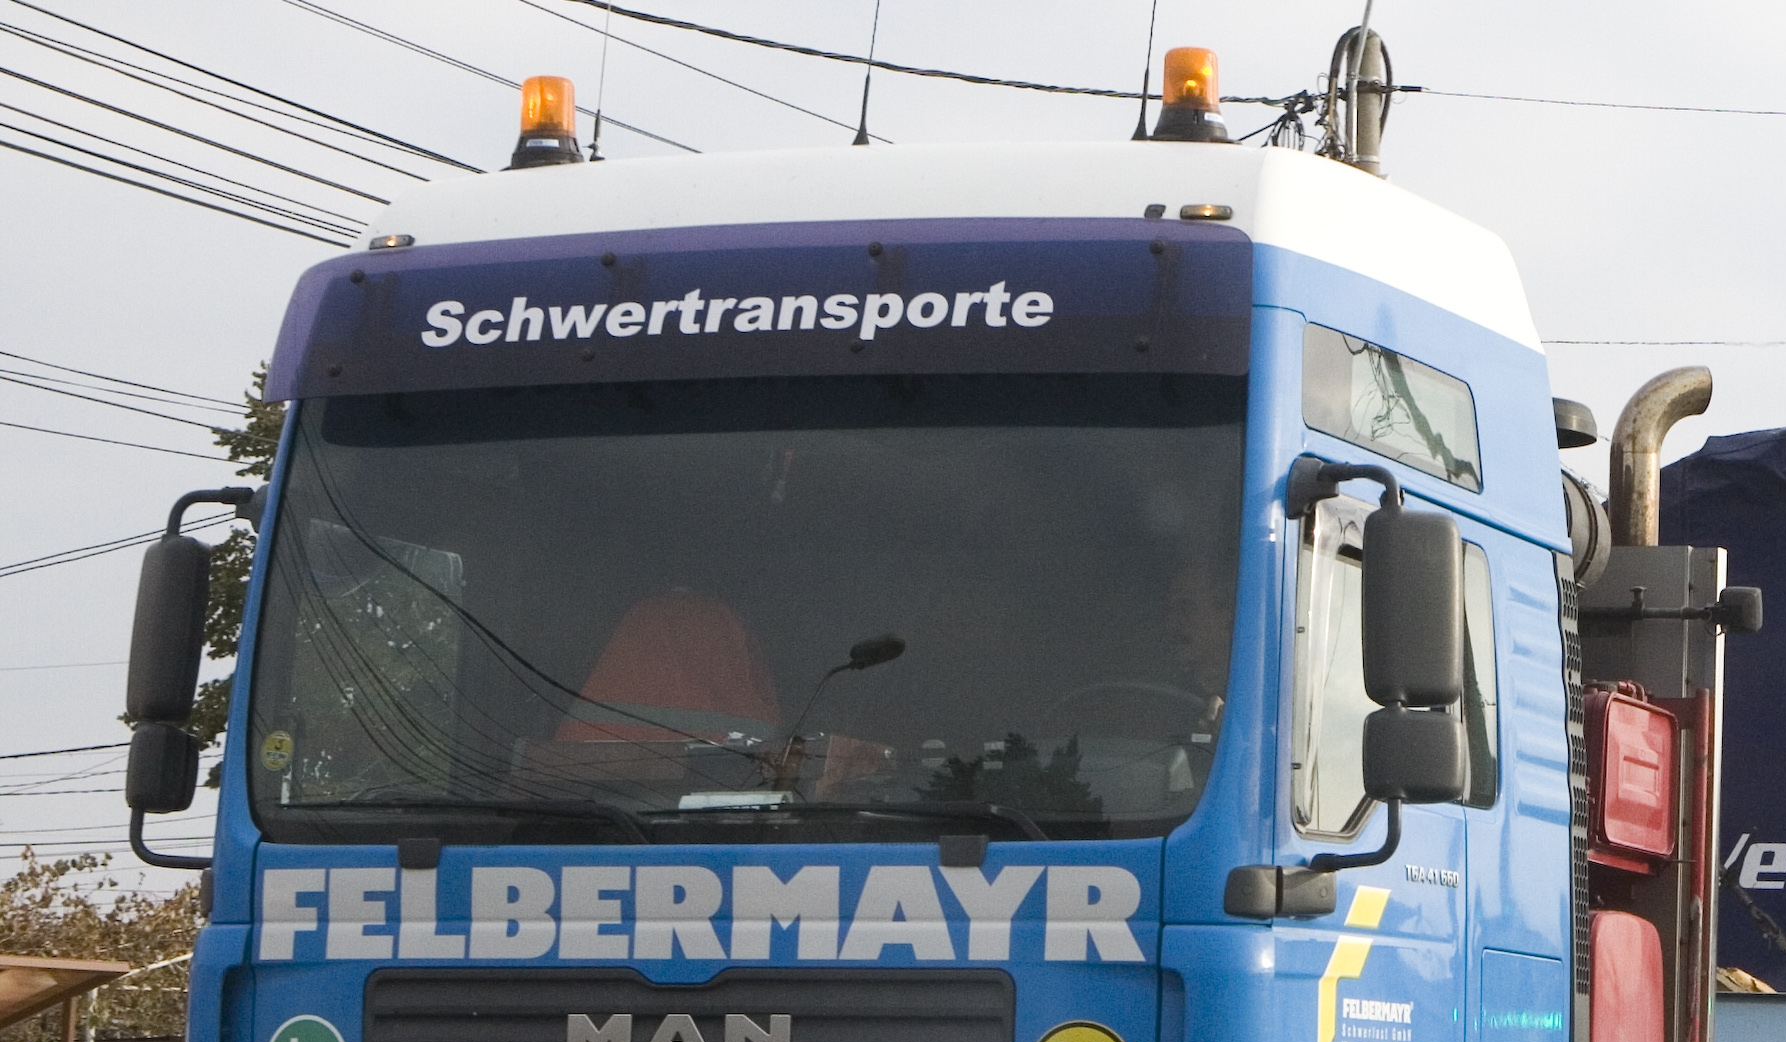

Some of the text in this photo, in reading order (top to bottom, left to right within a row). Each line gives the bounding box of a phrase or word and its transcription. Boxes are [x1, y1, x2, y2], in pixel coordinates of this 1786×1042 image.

[421, 281, 1055, 347] Schwertransporte
[1404, 864, 1459, 888] TGA 41 660
[258, 866, 1146, 962] FELBERMAYR
[1342, 998, 1412, 1024] FELBERMAYR
[1392, 1027, 1412, 1042] GmbH
